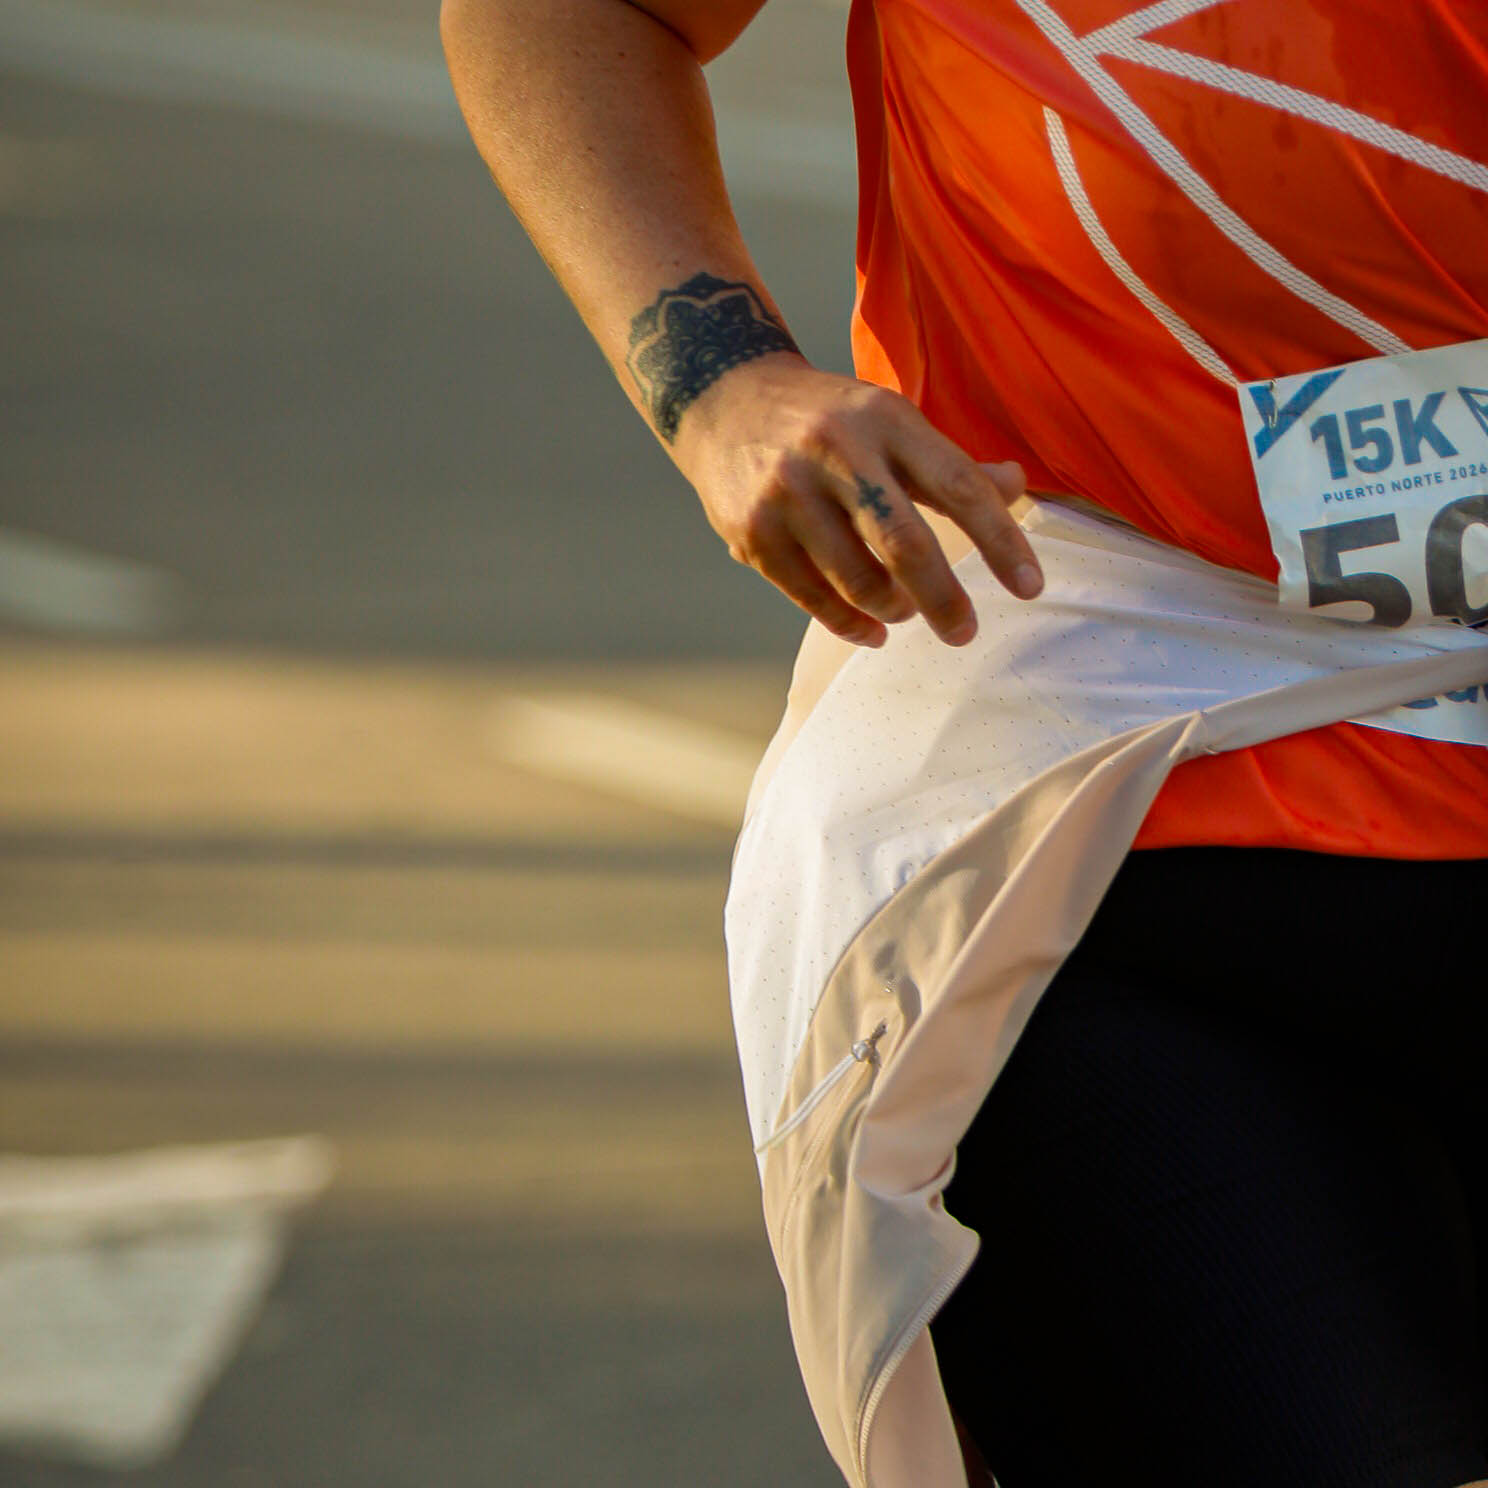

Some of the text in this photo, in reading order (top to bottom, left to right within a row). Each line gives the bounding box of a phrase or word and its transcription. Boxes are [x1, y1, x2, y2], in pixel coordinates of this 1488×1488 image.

[1310, 390, 1460, 480] 15K
[1322, 483, 1386, 504] PUERTO
[1391, 472, 1443, 492] NORTE
[1450, 462, 1488, 481] 2026
